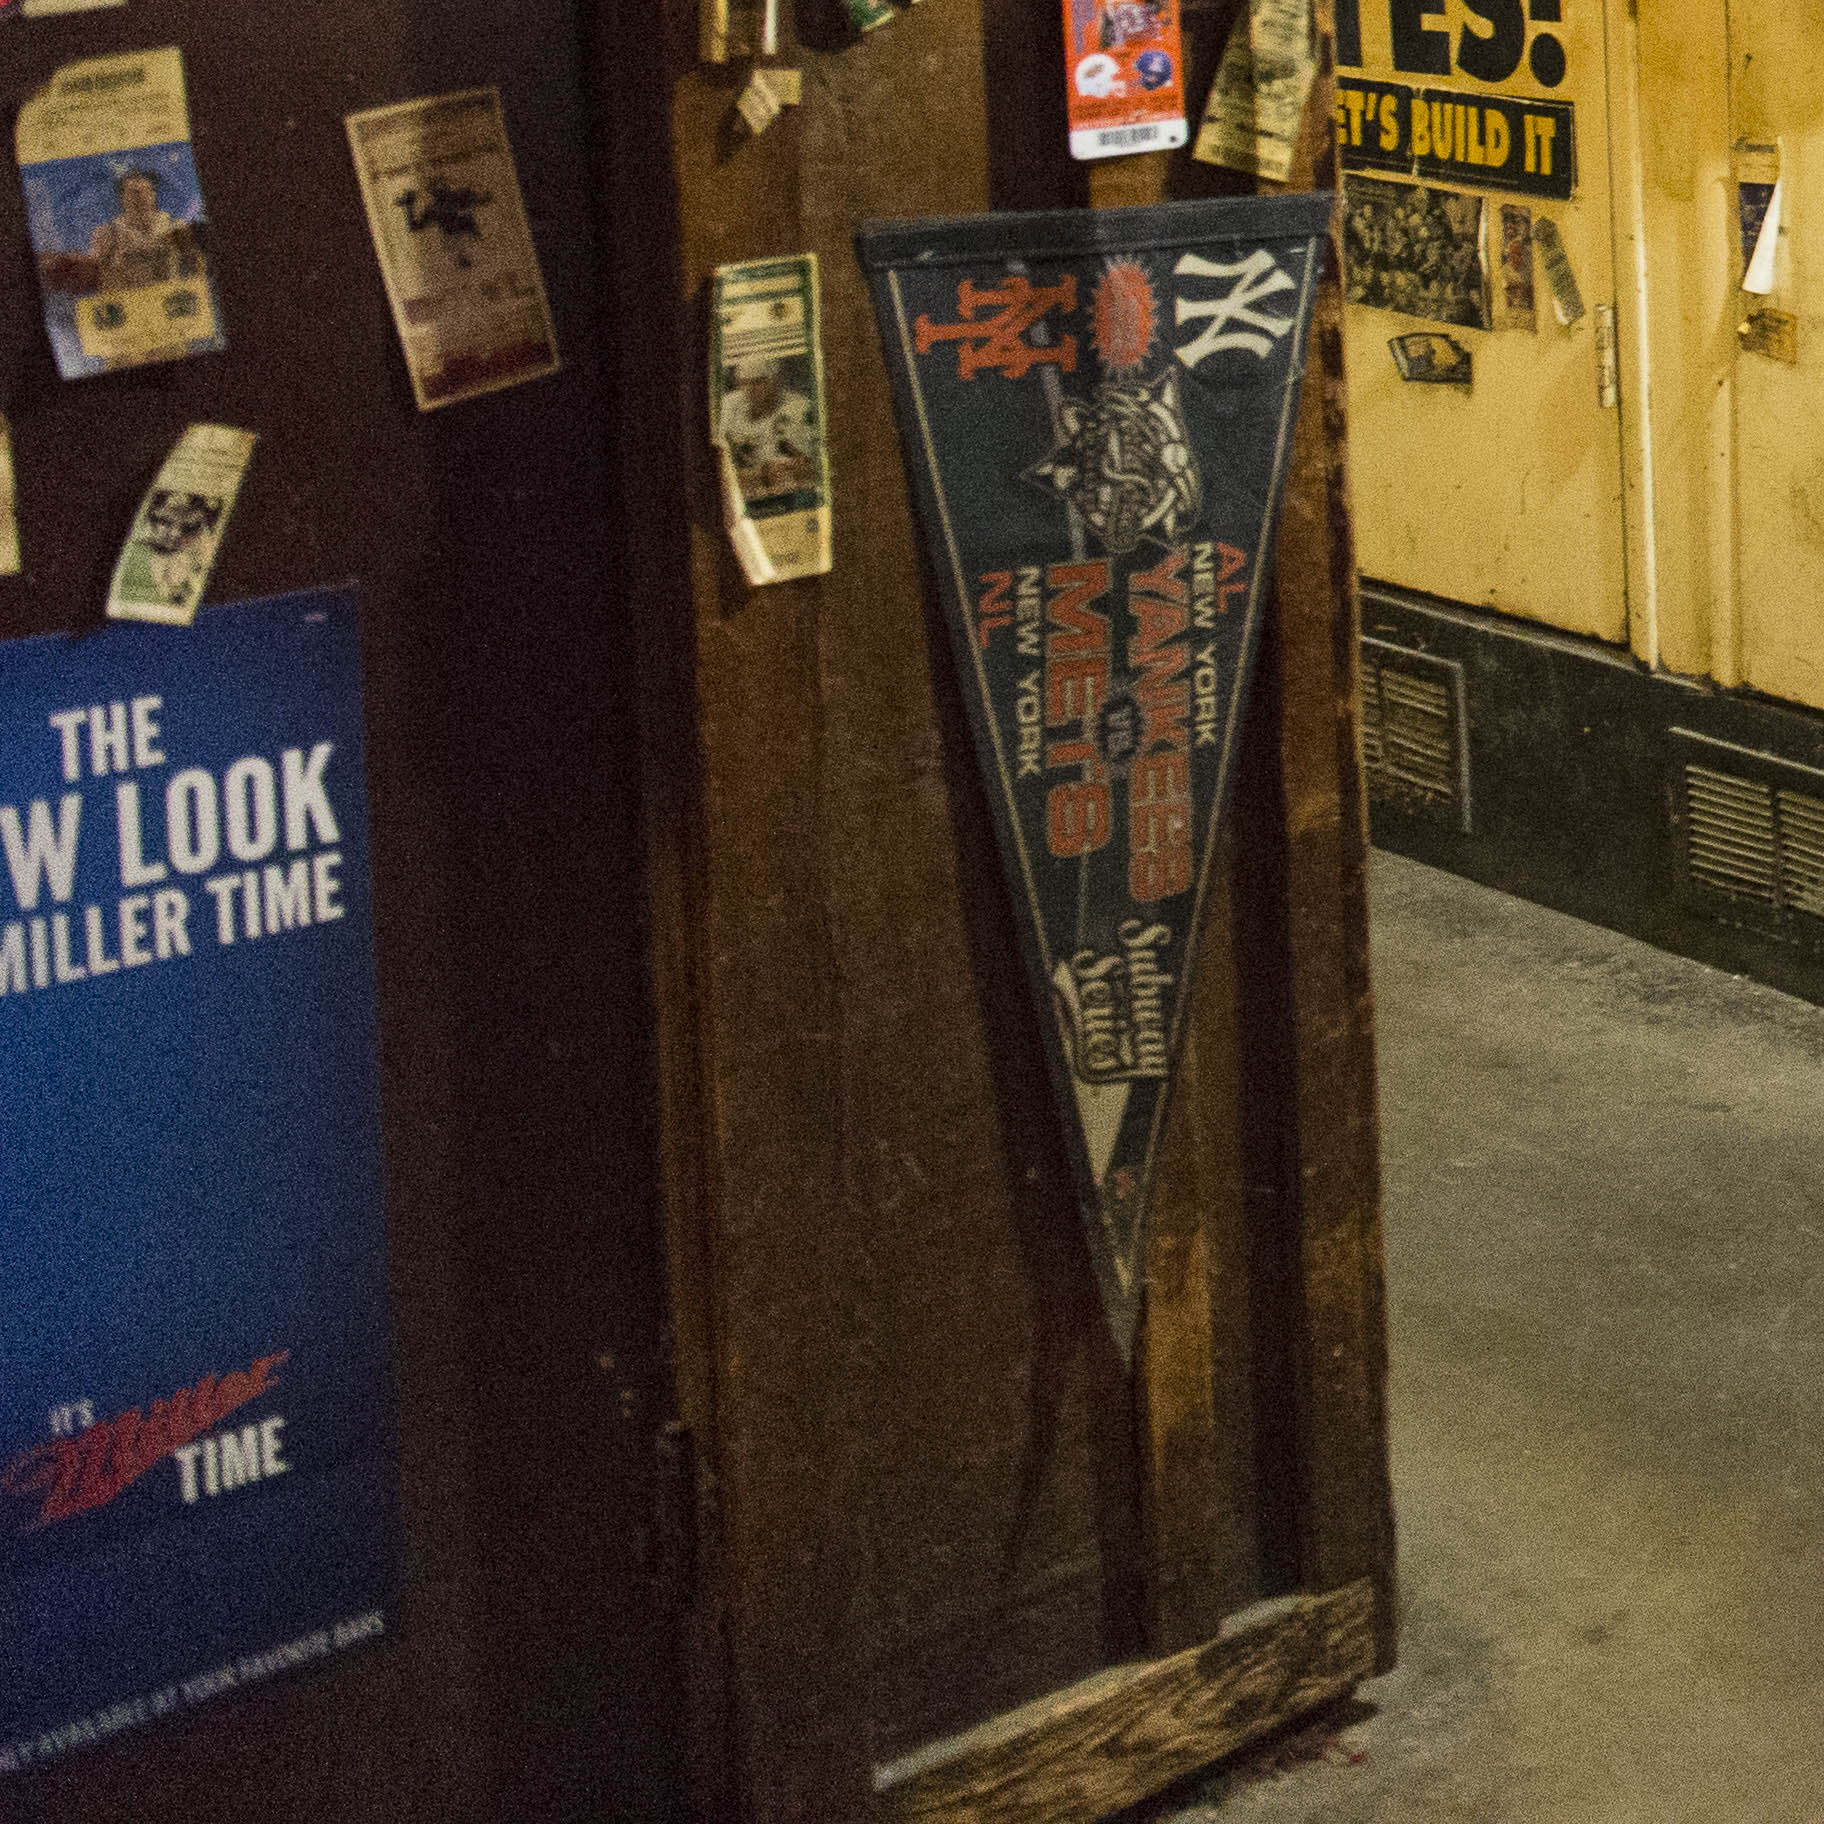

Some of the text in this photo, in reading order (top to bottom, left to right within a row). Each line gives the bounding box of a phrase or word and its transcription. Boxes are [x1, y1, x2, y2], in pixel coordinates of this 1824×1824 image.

[1411, 97, 1510, 168] BUILD
[1523, 113, 1556, 176] IT
[977, 570, 1012, 648] NL
[1214, 541, 1246, 614] AL
[1015, 565, 1042, 779] NEW YORK
[1190, 542, 1218, 747] NEW YORK
[50, 694, 166, 782] THE
[1045, 560, 1112, 858] METS
[1127, 549, 1193, 902] YANKEES
[0, 741, 340, 911] W LOOK
[204, 851, 346, 946] TIME
[1114, 918, 1174, 1080] Subway
[49, 1398, 97, 1436] IT'S
[174, 1414, 292, 1506] TIME
